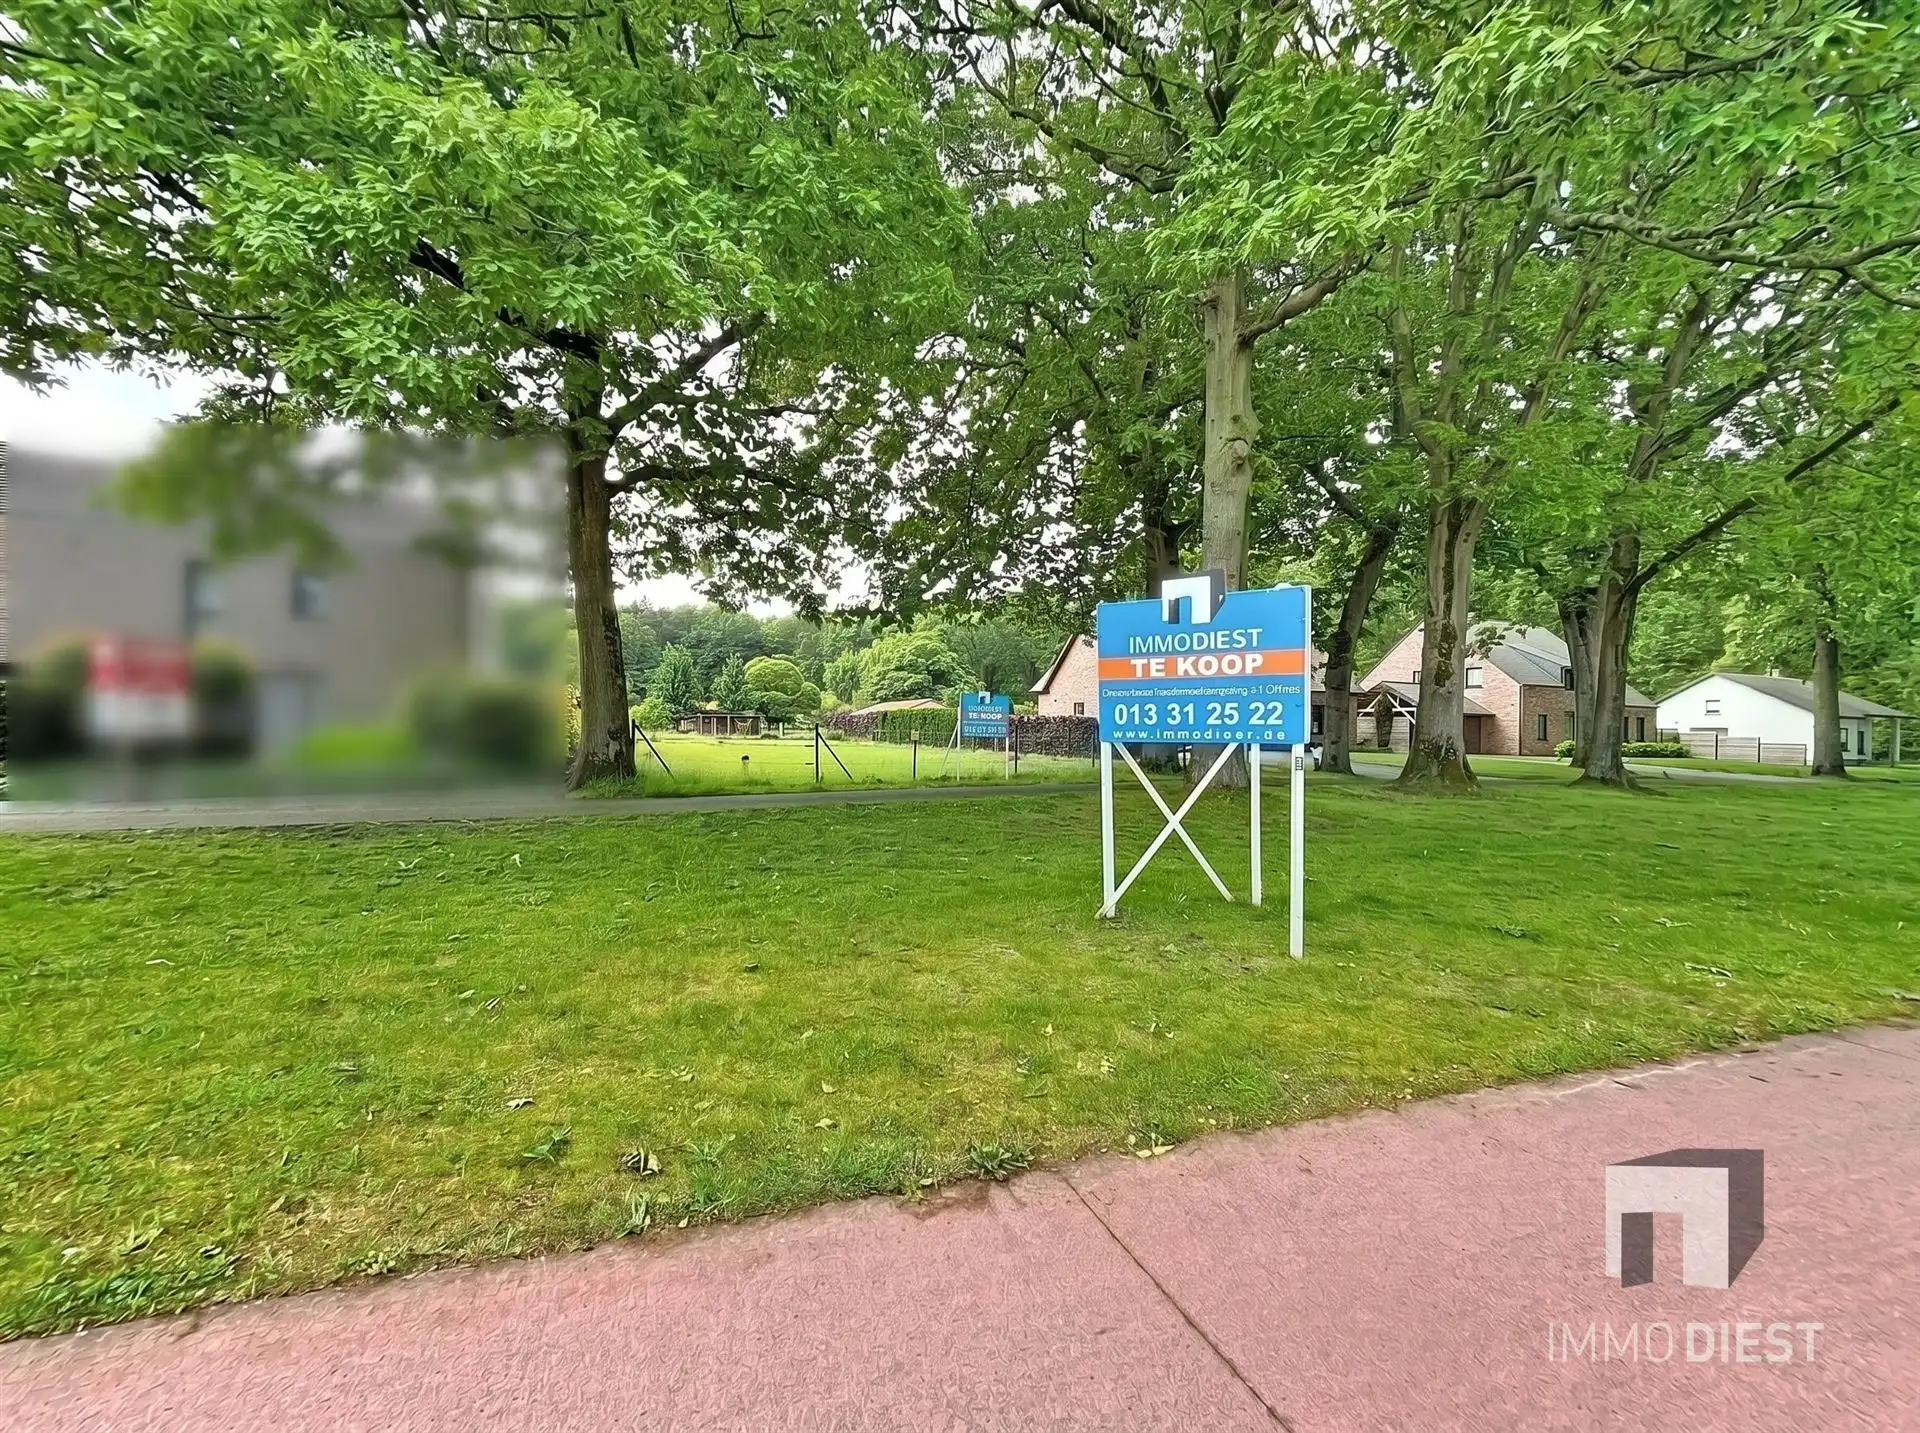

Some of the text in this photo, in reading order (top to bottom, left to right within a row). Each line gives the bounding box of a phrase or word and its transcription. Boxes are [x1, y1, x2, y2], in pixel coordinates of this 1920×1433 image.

[1130, 653, 1263, 678] TE KOOP
[1114, 701, 1284, 725] 013 31 25 22
